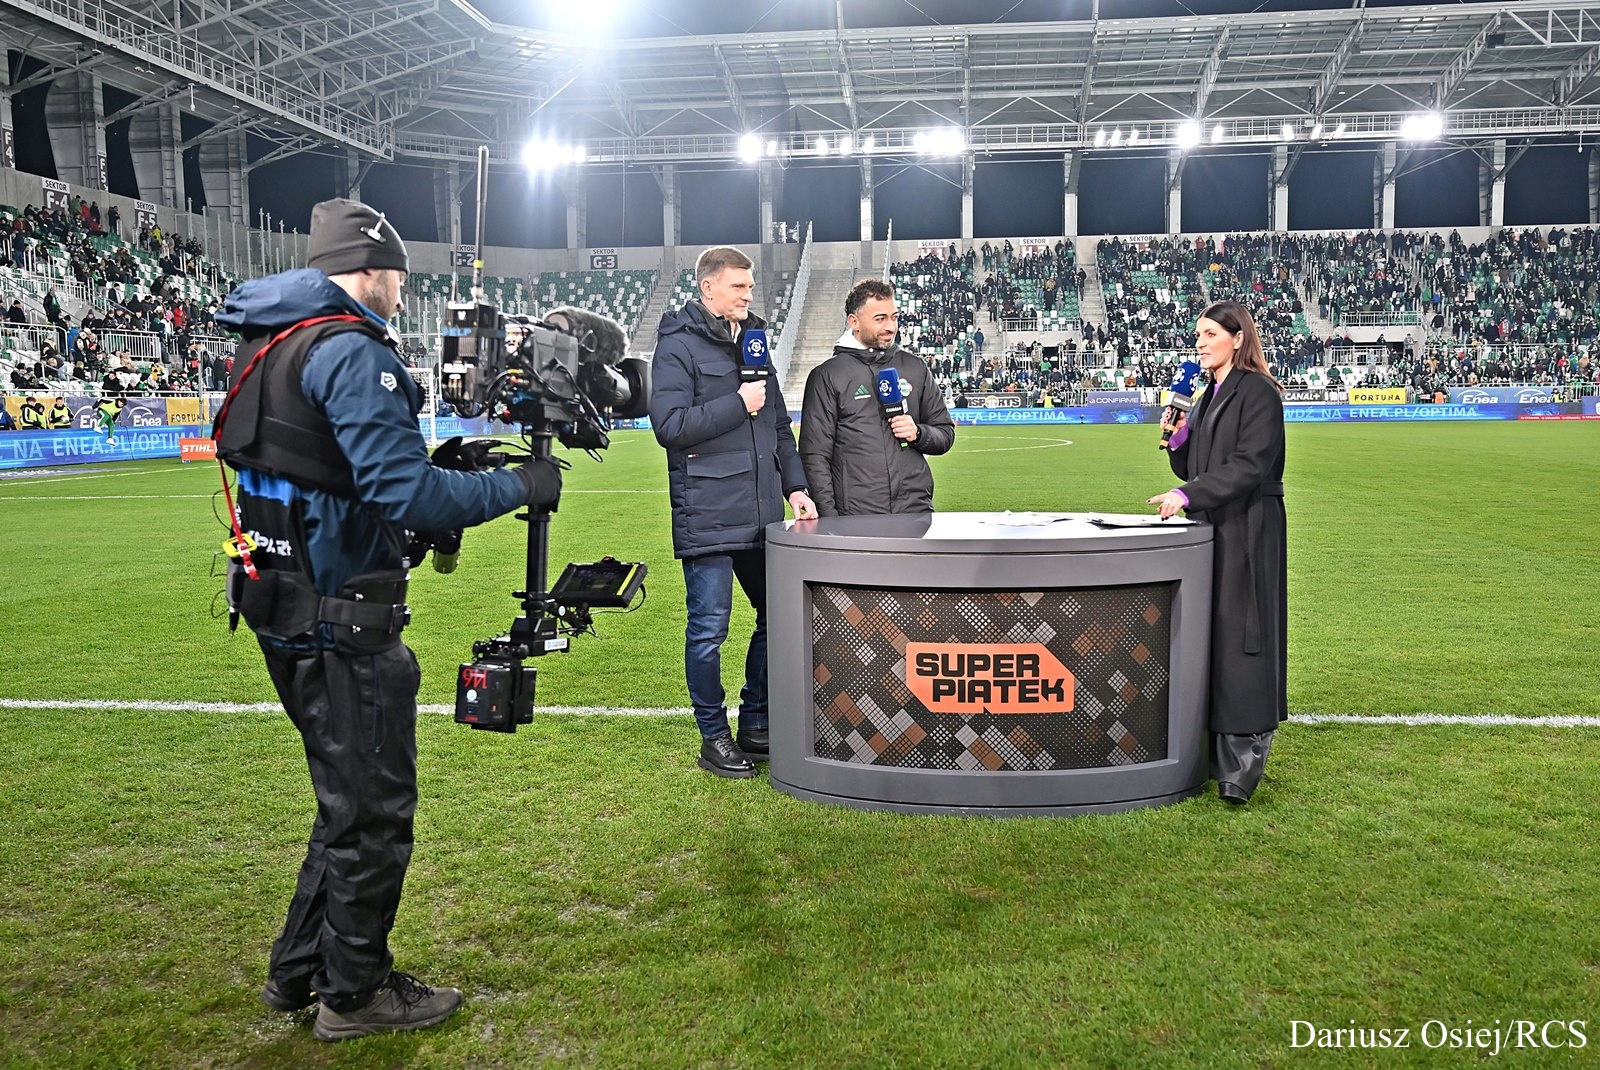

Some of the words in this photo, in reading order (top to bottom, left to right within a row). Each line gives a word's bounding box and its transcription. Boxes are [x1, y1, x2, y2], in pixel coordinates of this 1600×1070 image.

[45, 180, 67, 191] SEKTOR
[46, 191, 69, 211] F-4
[136, 201, 155, 211] SEKTOR
[137, 211, 156, 229] F-5
[593, 256, 615, 268] G-3
[1095, 396, 1139, 404] CONFIRME
[1285, 392, 1320, 400] CANAL+
[1462, 394, 1498, 404] Enea
[1321, 408, 1343, 418] NA
[1349, 406, 1477, 418] ENEA.PL/OPTIMA
[133, 415, 162, 427] Enea
[13, 440, 43, 459] NA
[182, 444, 214, 453] STIHL
[915, 652, 1040, 678] SUPER
